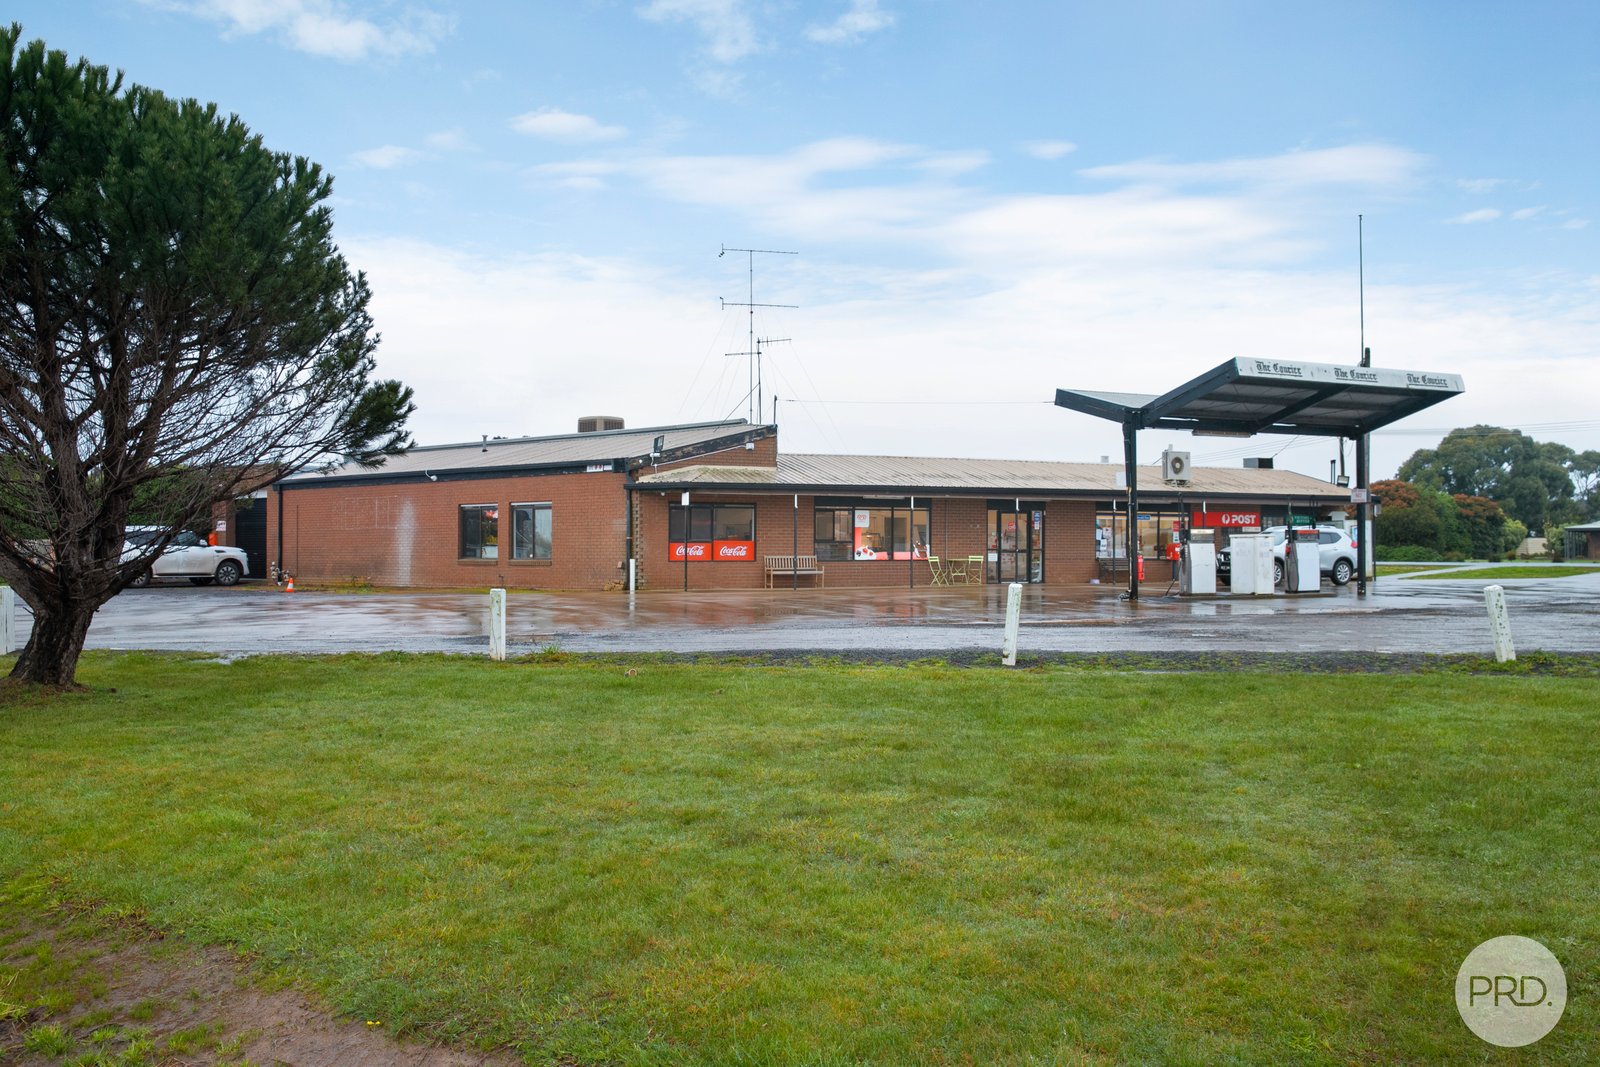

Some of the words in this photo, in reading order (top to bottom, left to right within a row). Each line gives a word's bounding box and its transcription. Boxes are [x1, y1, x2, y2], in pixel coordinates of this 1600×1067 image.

[1255, 360, 1271, 372] The
[1273, 362, 1302, 375] Courier
[1334, 367, 1348, 378] The
[1350, 369, 1378, 380] Courier
[1406, 373, 1420, 383] The
[1421, 374, 1448, 386] Courier
[1231, 514, 1257, 525] POST
[720, 545, 747, 556] Coca-Cola
